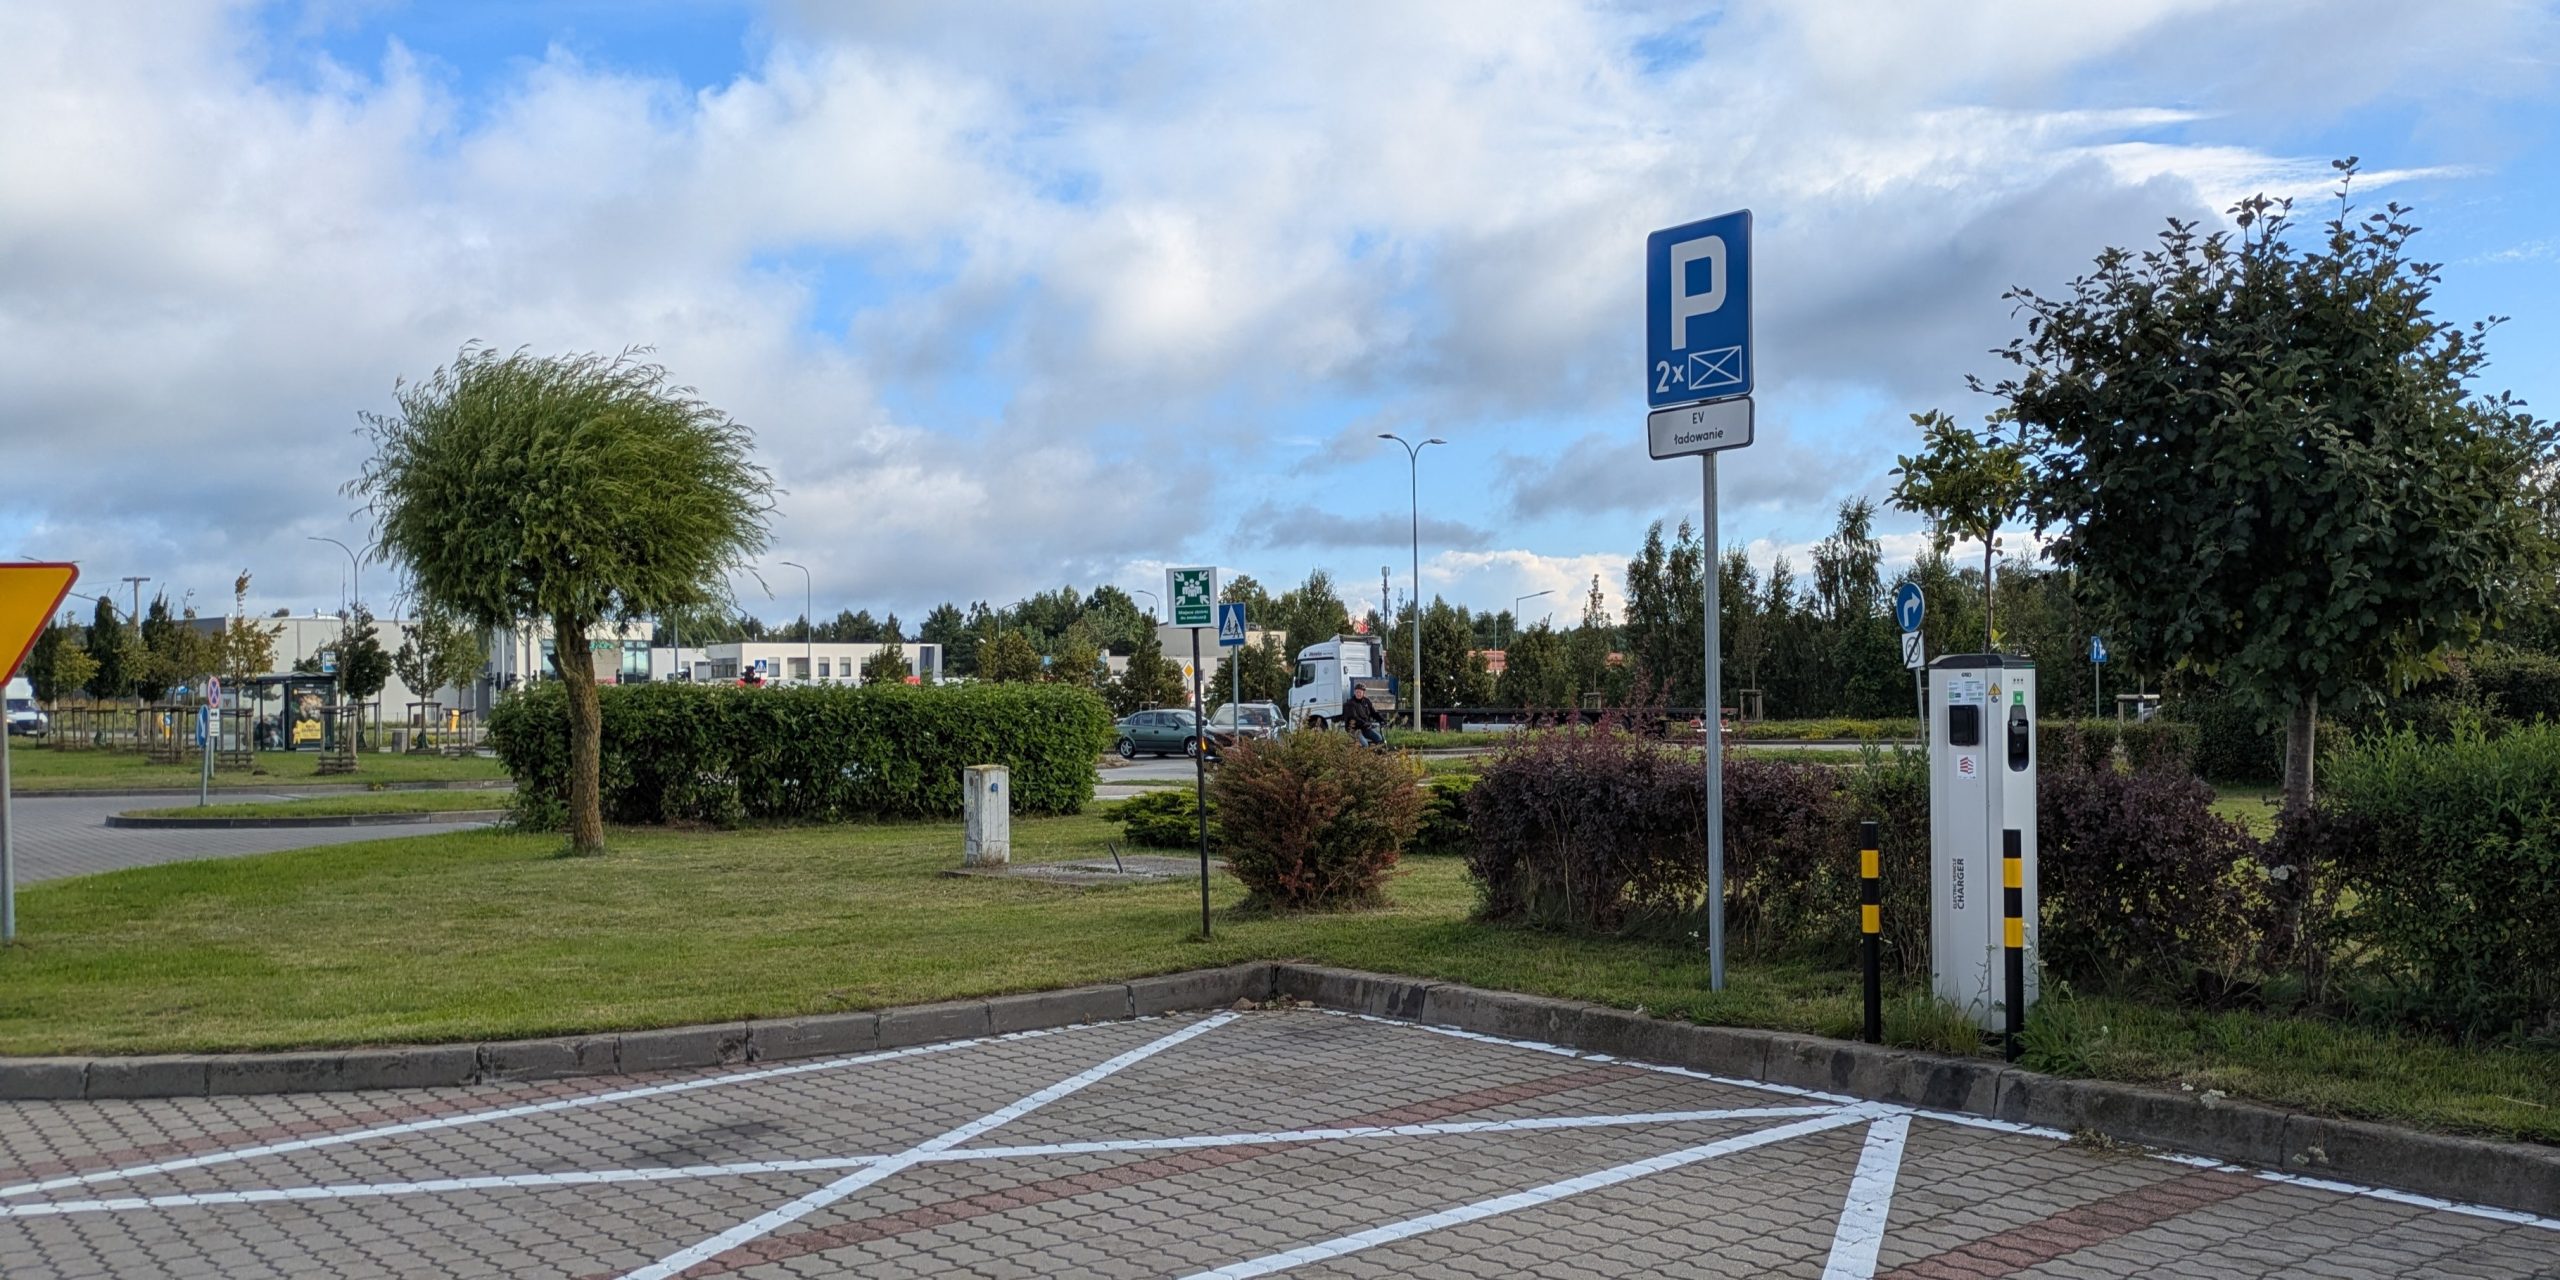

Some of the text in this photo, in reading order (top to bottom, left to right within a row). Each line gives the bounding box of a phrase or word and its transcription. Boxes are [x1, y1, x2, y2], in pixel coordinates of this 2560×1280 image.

[1671, 235, 1727, 351] P
[1655, 360, 1685, 394] 2x
[1692, 411, 1705, 425] EV
[1674, 428, 1724, 446] ładowanie
